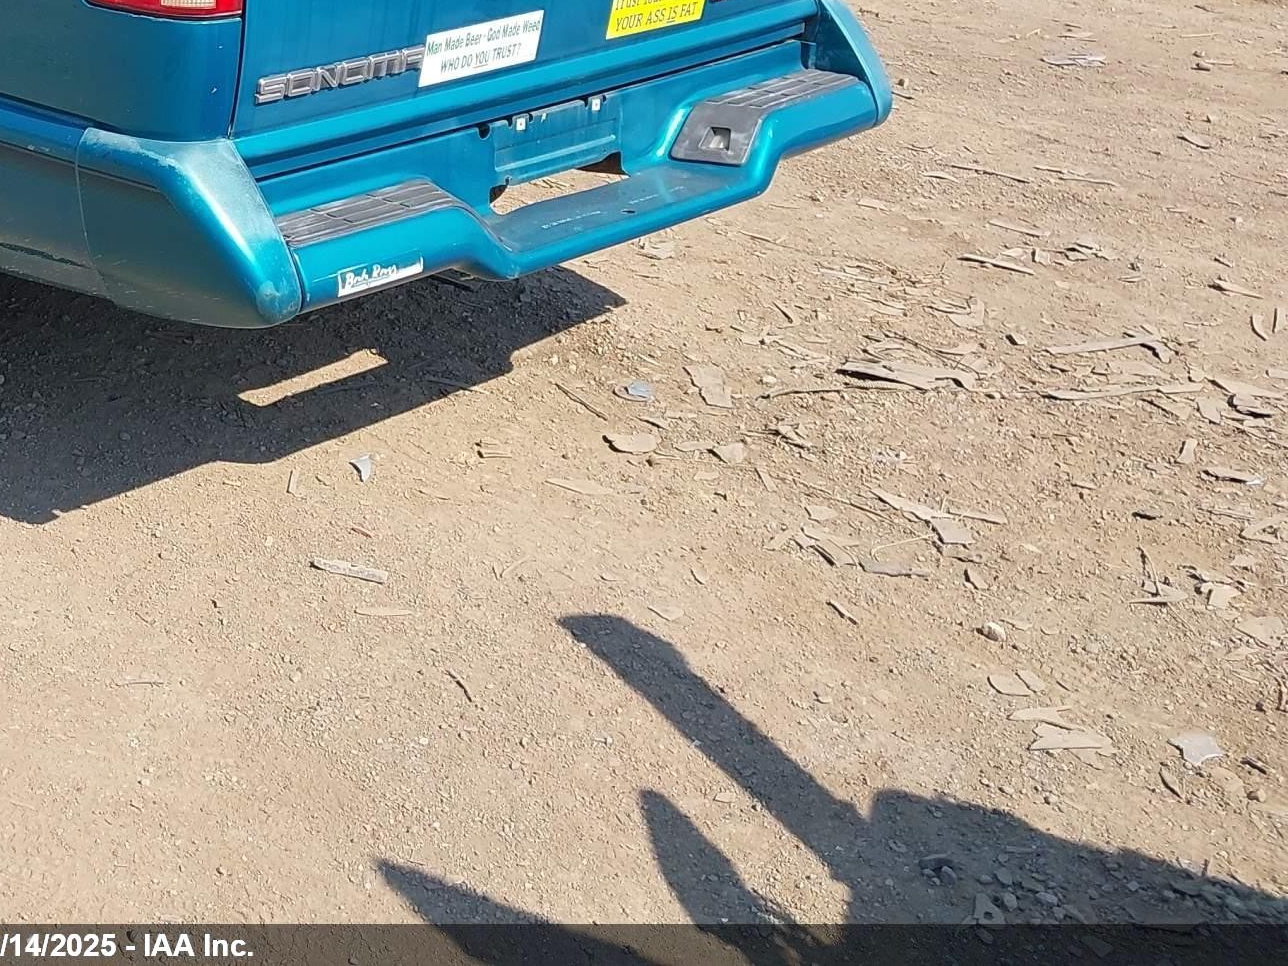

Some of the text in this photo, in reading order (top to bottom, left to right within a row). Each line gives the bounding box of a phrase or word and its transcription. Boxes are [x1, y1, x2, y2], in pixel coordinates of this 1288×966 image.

[615, 2, 698, 31] YOUR ASS IS FAT
[426, 41, 442, 56] Man
[444, 37, 463, 51] Made
[465, 32, 482, 47] Beer
[487, 25, 500, 42] God
[502, 21, 520, 39] Made
[522, 17, 541, 34] Weed
[440, 43, 521, 73] WHO DO YOU TRUST?
